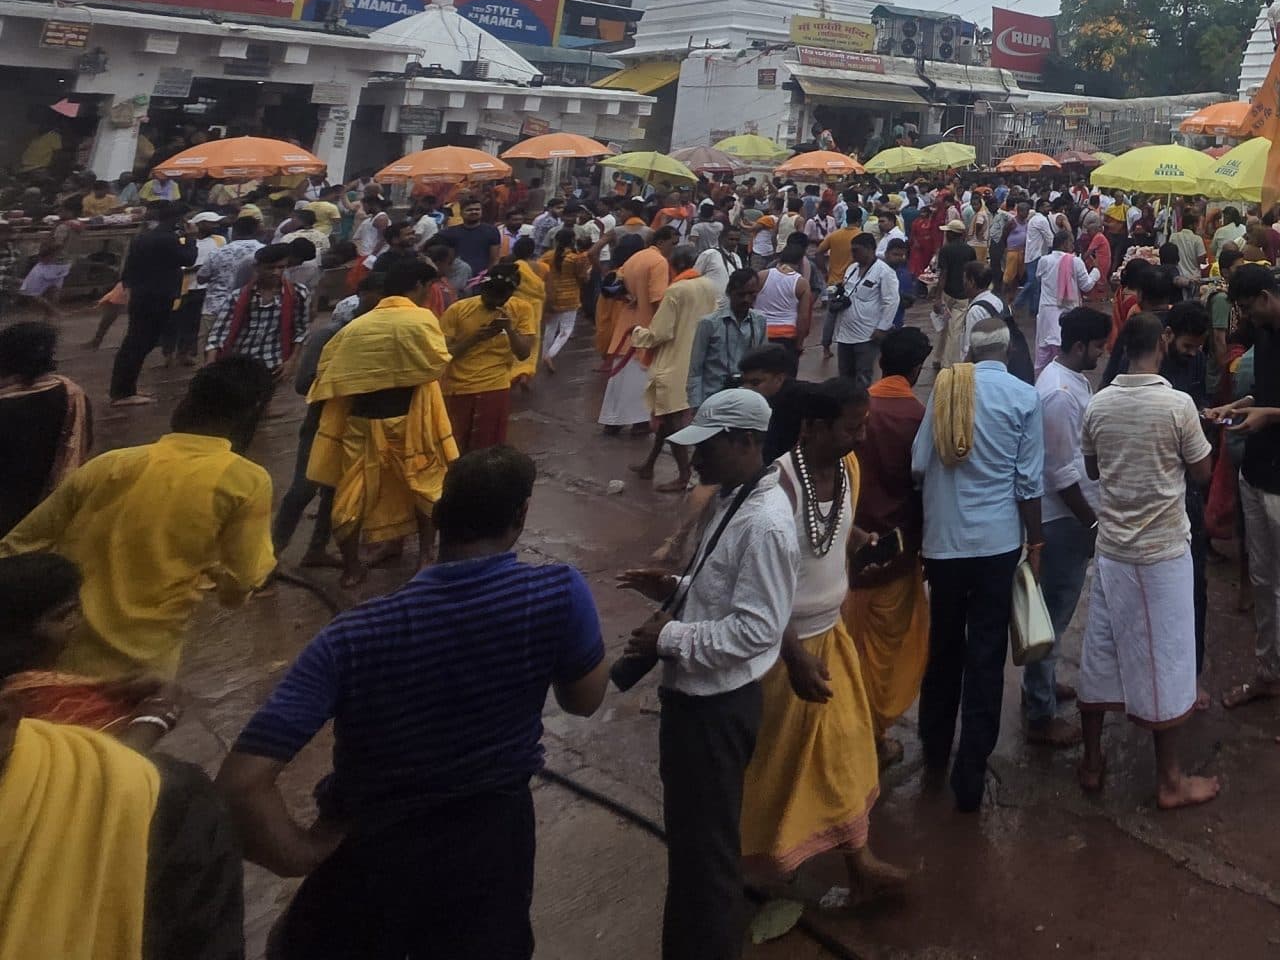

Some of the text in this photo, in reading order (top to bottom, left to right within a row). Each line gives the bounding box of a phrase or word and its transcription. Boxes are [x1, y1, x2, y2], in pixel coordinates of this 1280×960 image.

[485, 4, 520, 18] STYLE
[478, 13, 524, 30] MAMLA
[1011, 30, 1051, 49] RUPA
